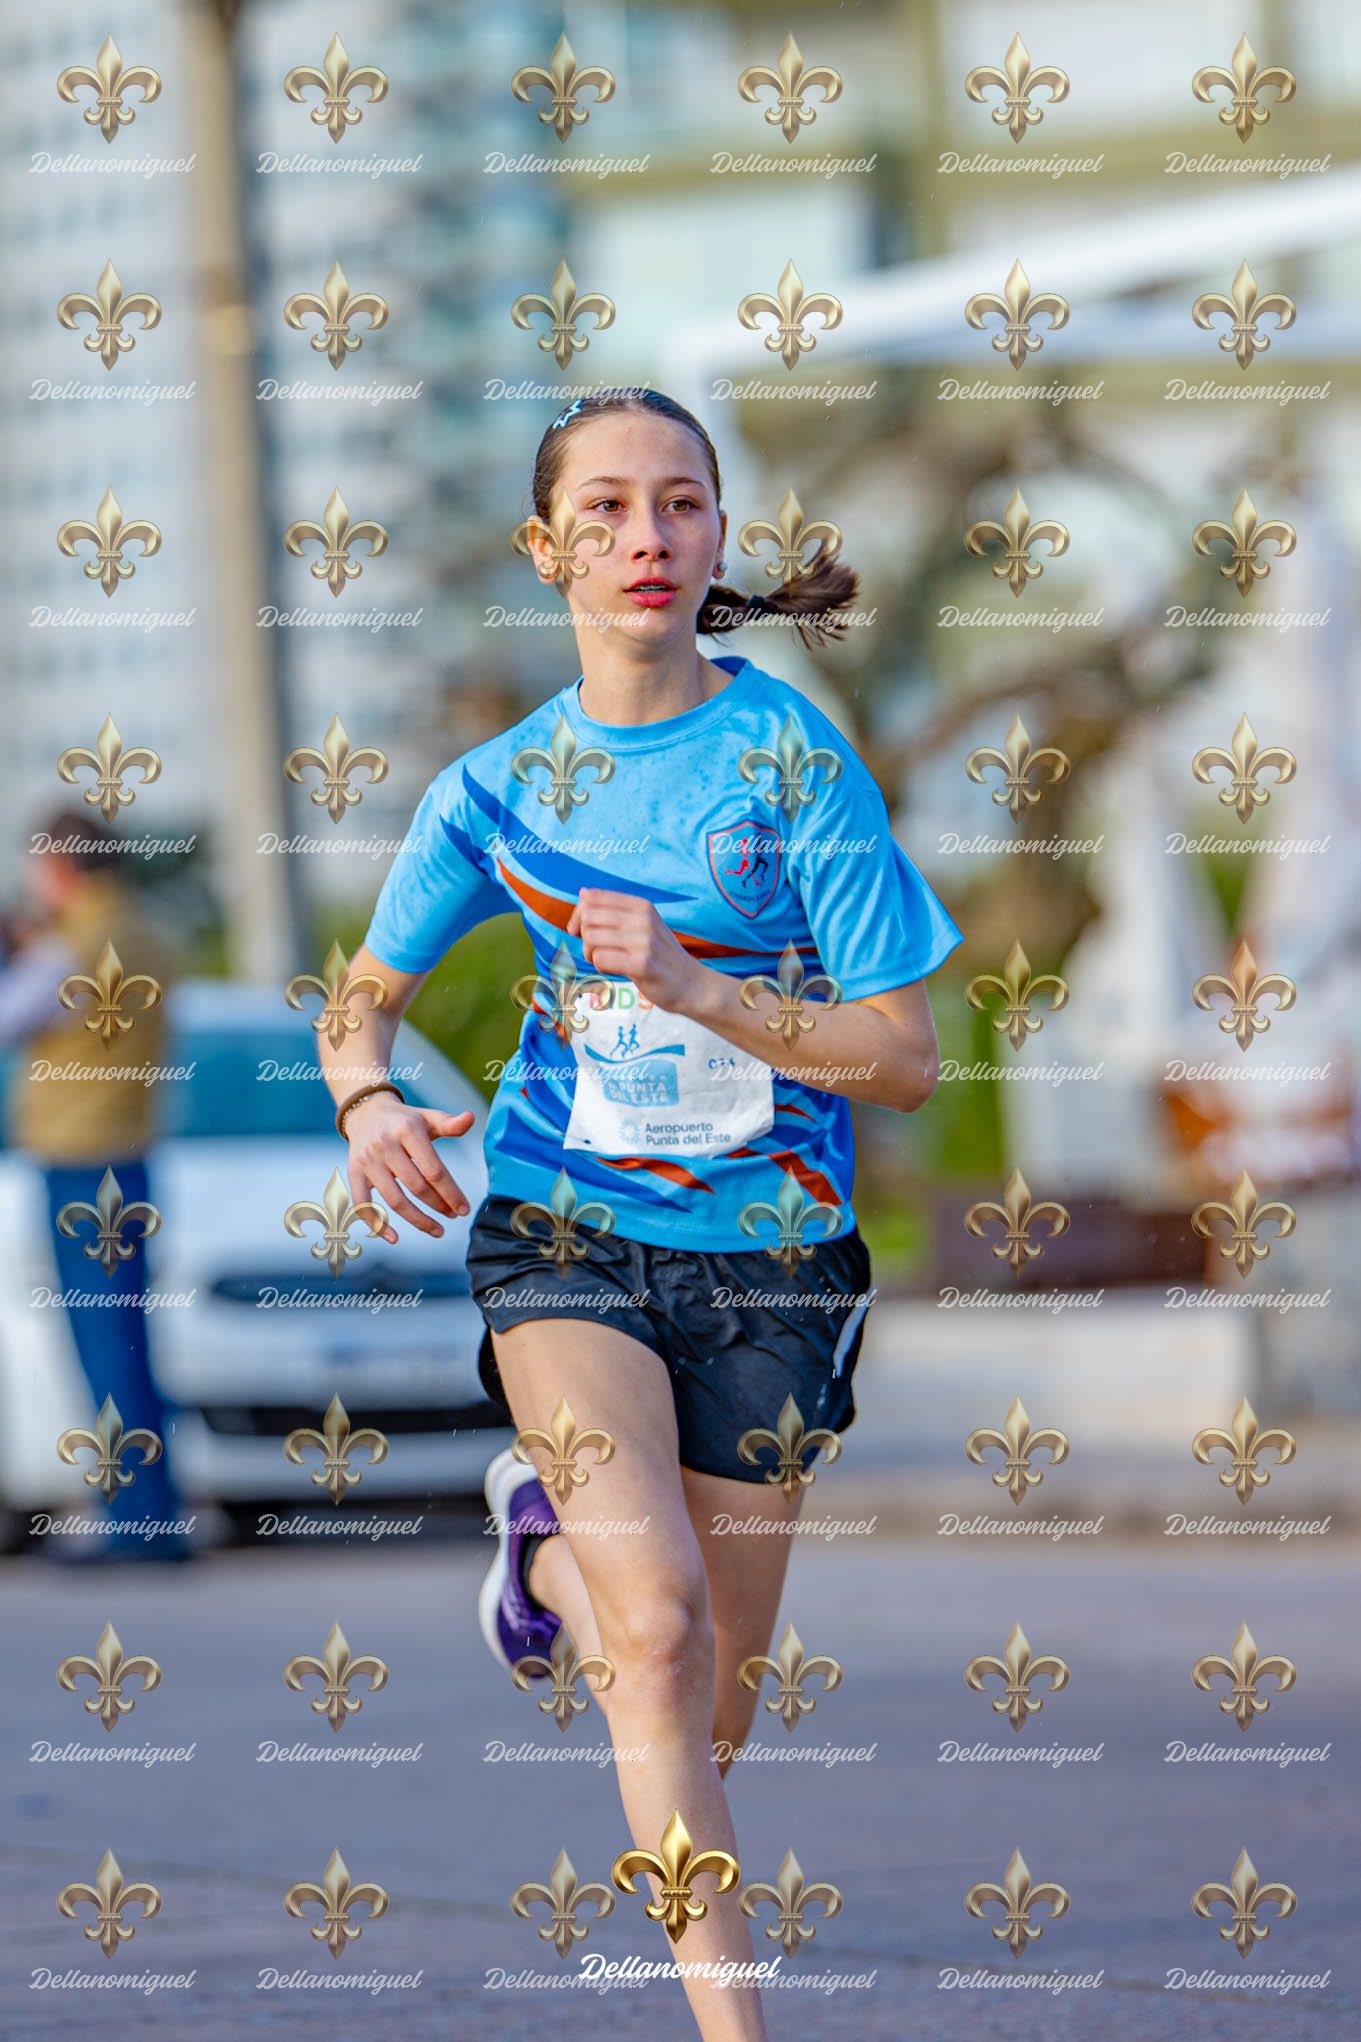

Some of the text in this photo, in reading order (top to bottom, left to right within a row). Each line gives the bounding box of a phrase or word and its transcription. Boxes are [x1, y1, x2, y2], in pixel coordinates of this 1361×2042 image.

[645, 1122, 714, 1135] Aeropuerto
[645, 1132, 732, 1146] Punta del Este
